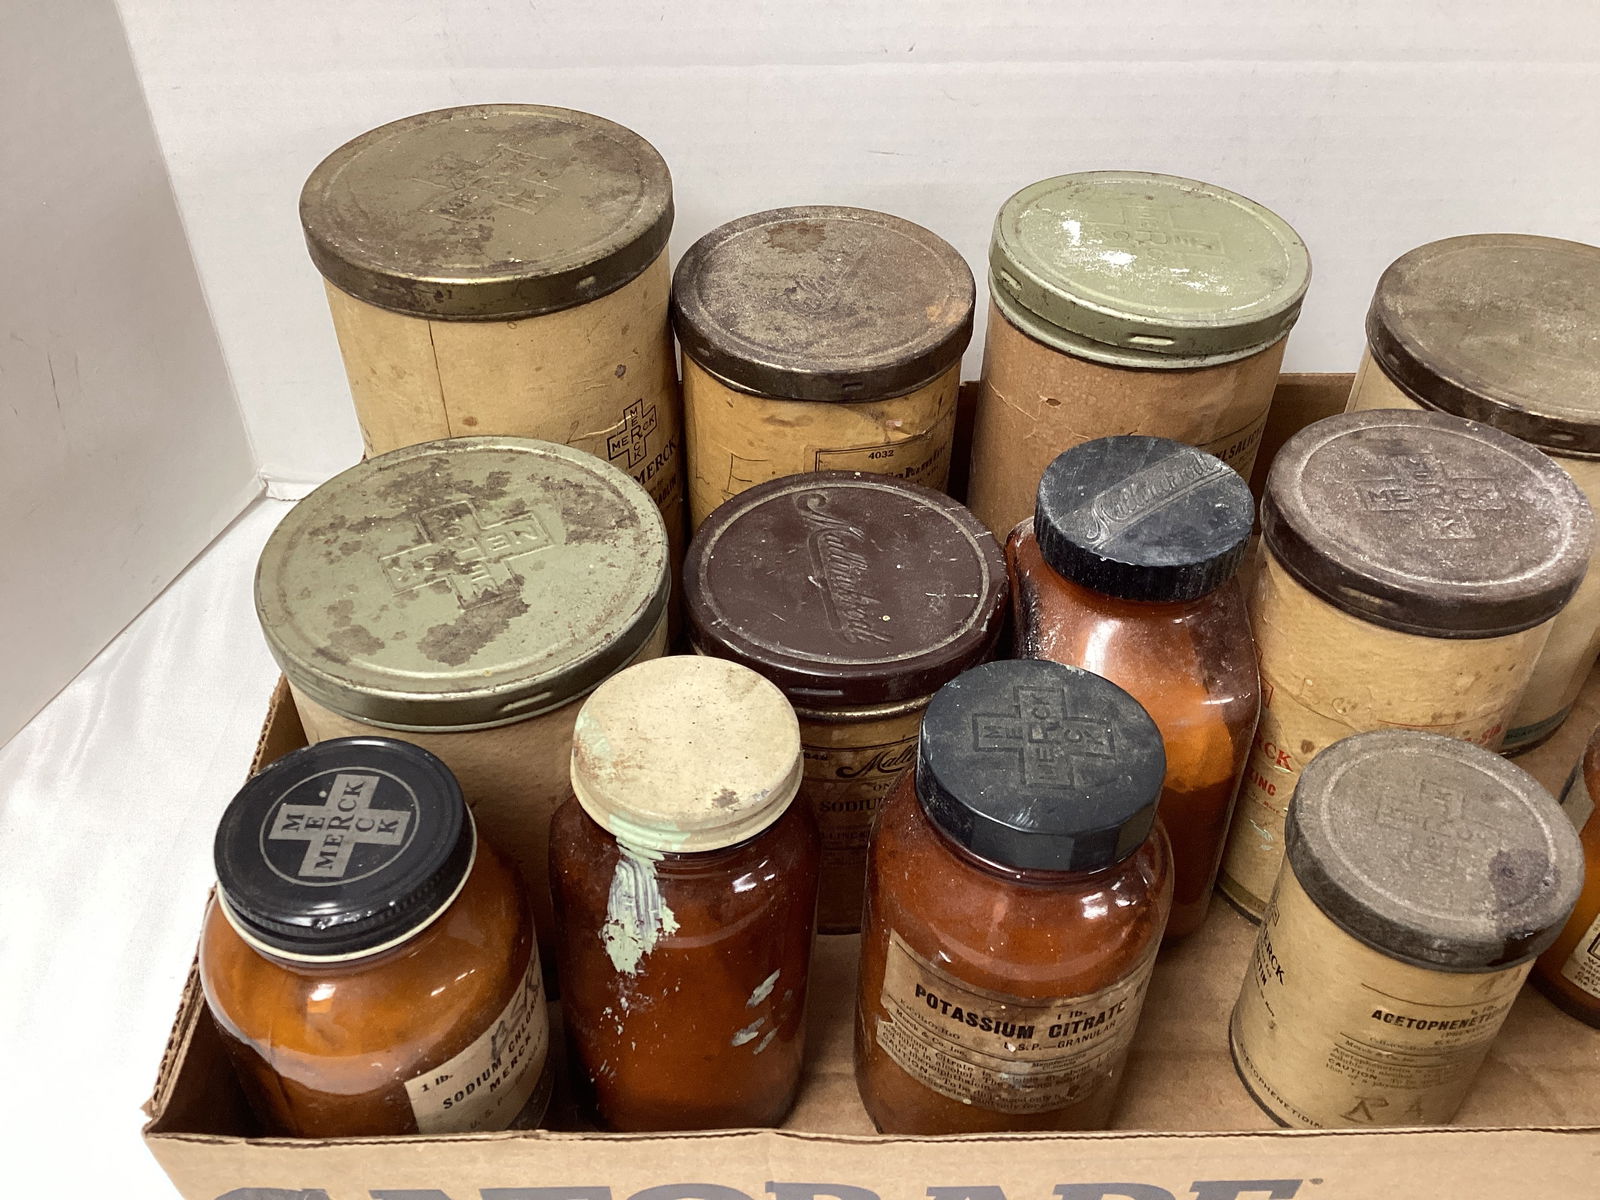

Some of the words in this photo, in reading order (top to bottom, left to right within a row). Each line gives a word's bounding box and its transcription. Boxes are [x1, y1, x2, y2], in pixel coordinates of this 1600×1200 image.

[611, 414, 655, 452] MERCK
[868, 449, 895, 460] 4032
[819, 799, 879, 813] SODIU
[281, 812, 400, 837] MERCK
[314, 781, 367, 871] MERCK
[915, 983, 1035, 1039] POTASSIUM
[1048, 998, 1128, 1039] CITRATE
[1371, 1003, 1509, 1031] ACETOPHENETI
[435, 1073, 454, 1086] lb.
[489, 1033, 531, 1093] MERCK
[443, 1056, 502, 1110] SODIUM
